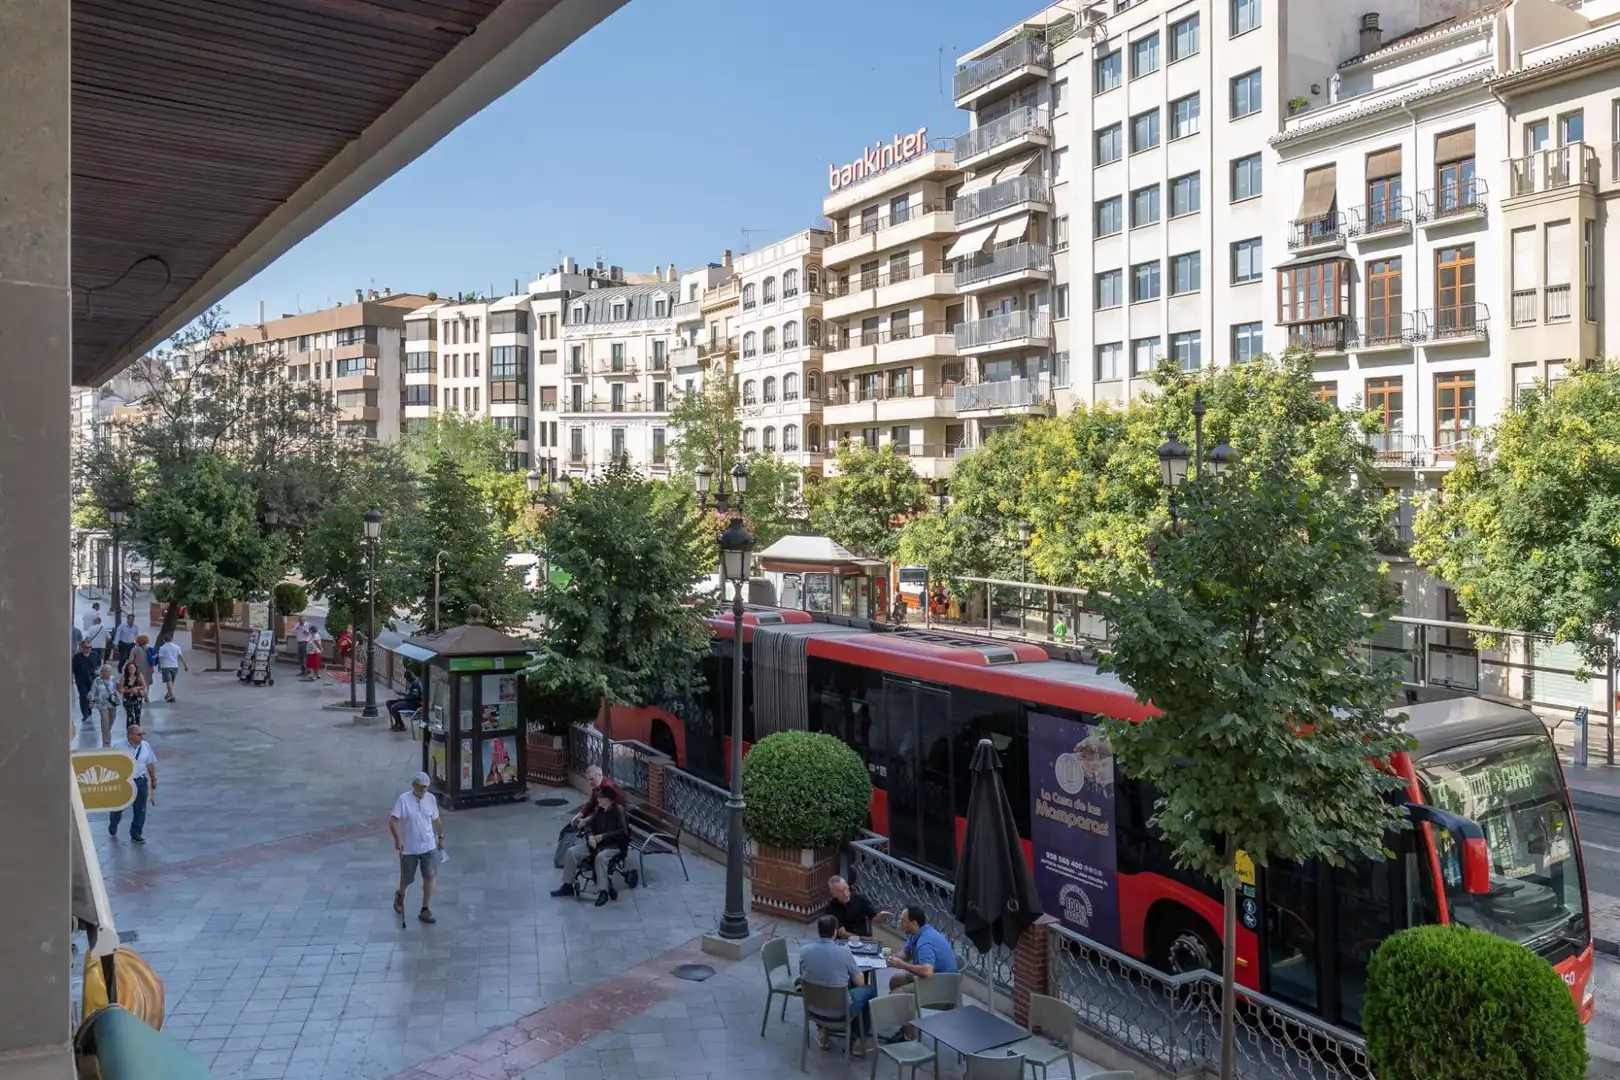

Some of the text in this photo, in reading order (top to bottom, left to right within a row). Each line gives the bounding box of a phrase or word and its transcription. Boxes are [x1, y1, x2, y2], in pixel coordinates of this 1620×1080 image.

[1041, 788, 1051, 801] La
[1035, 798, 1110, 837] Mamparas
[1071, 860, 1083, 870] 400
